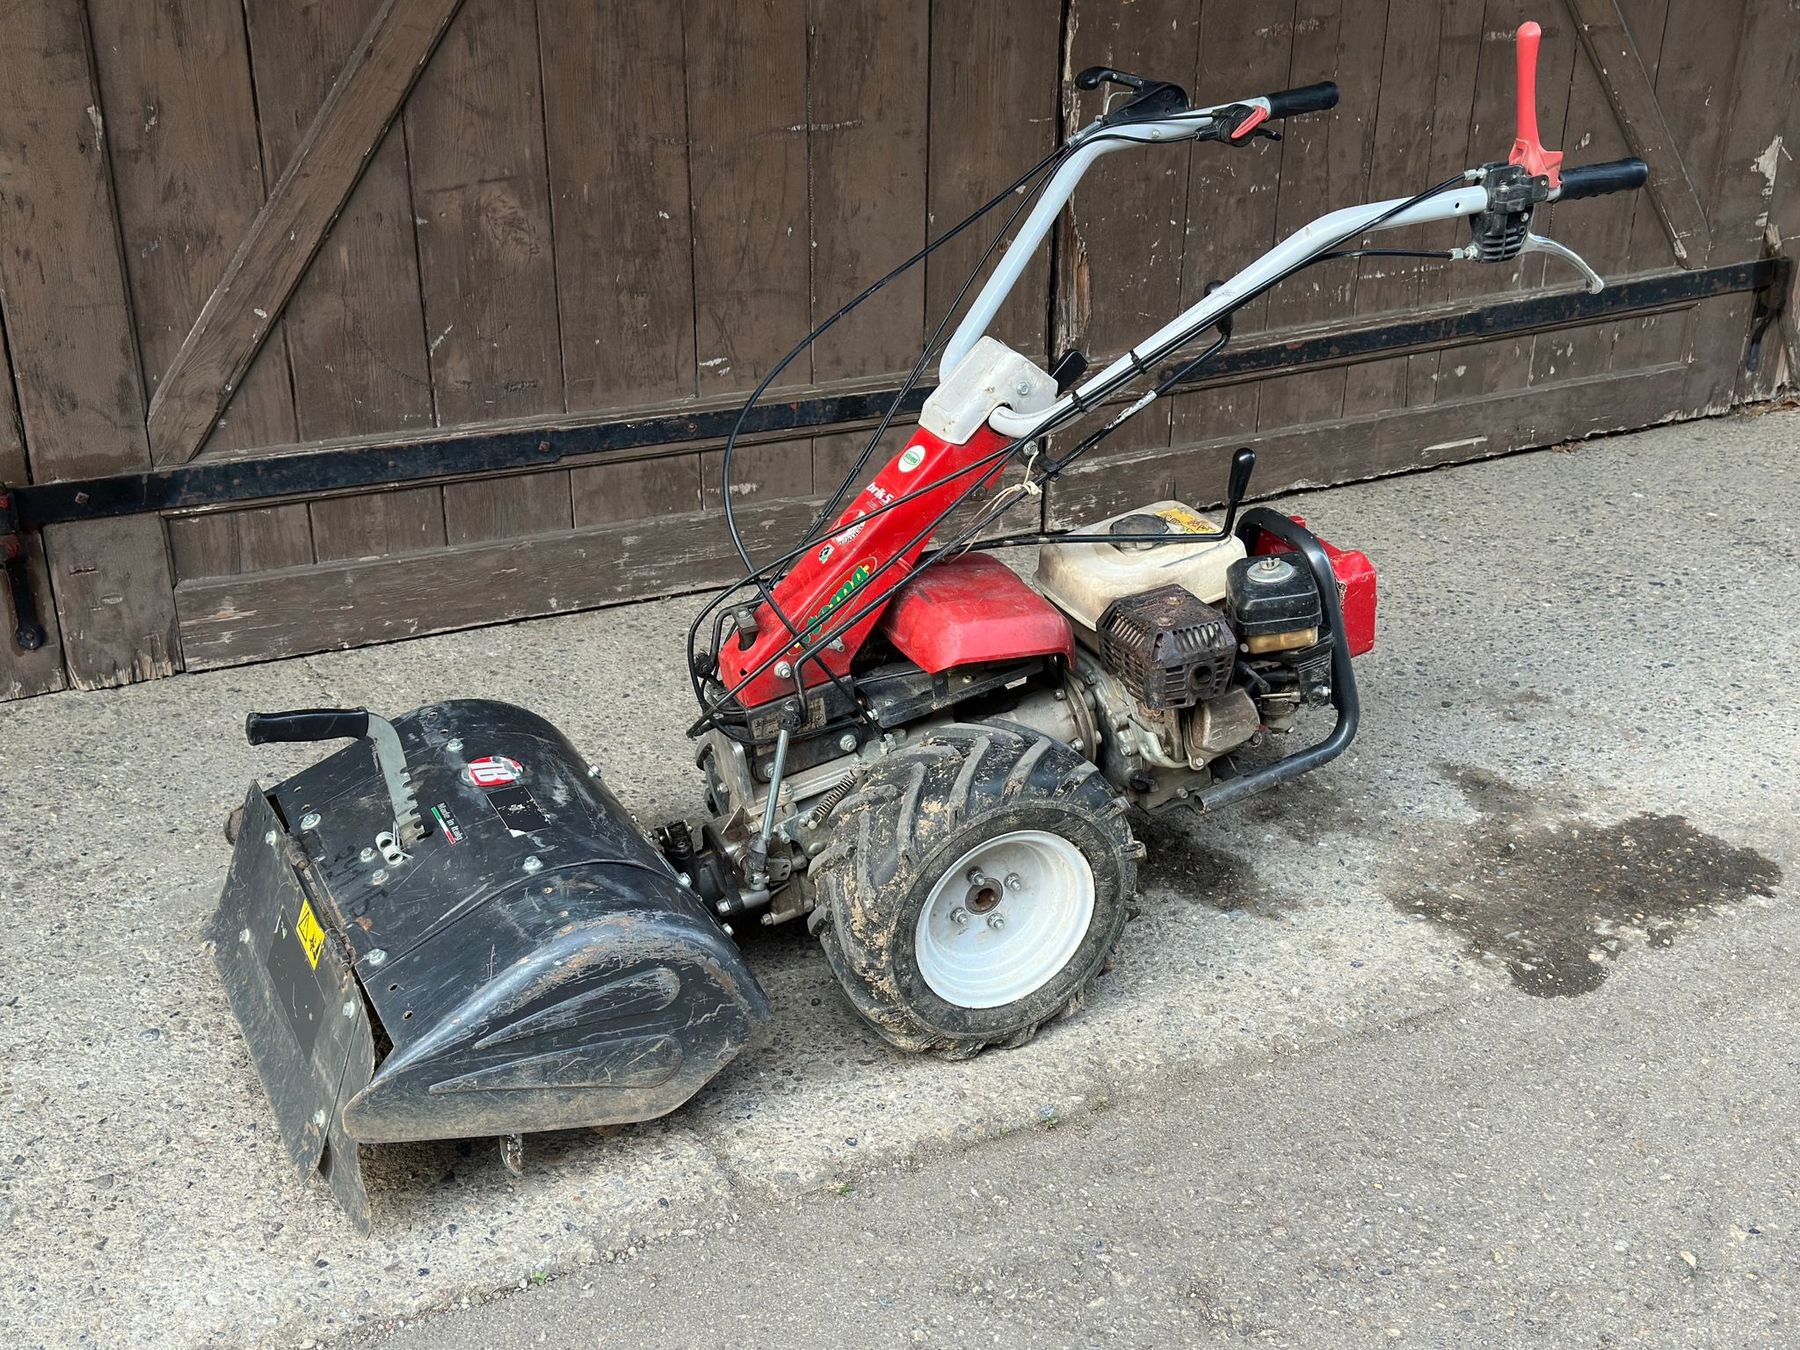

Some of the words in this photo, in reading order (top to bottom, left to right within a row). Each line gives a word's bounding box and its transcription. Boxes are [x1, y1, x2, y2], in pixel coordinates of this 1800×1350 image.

[437, 802, 451, 819] Made
[446, 818, 455, 827] in
[450, 825, 464, 841] Italy
